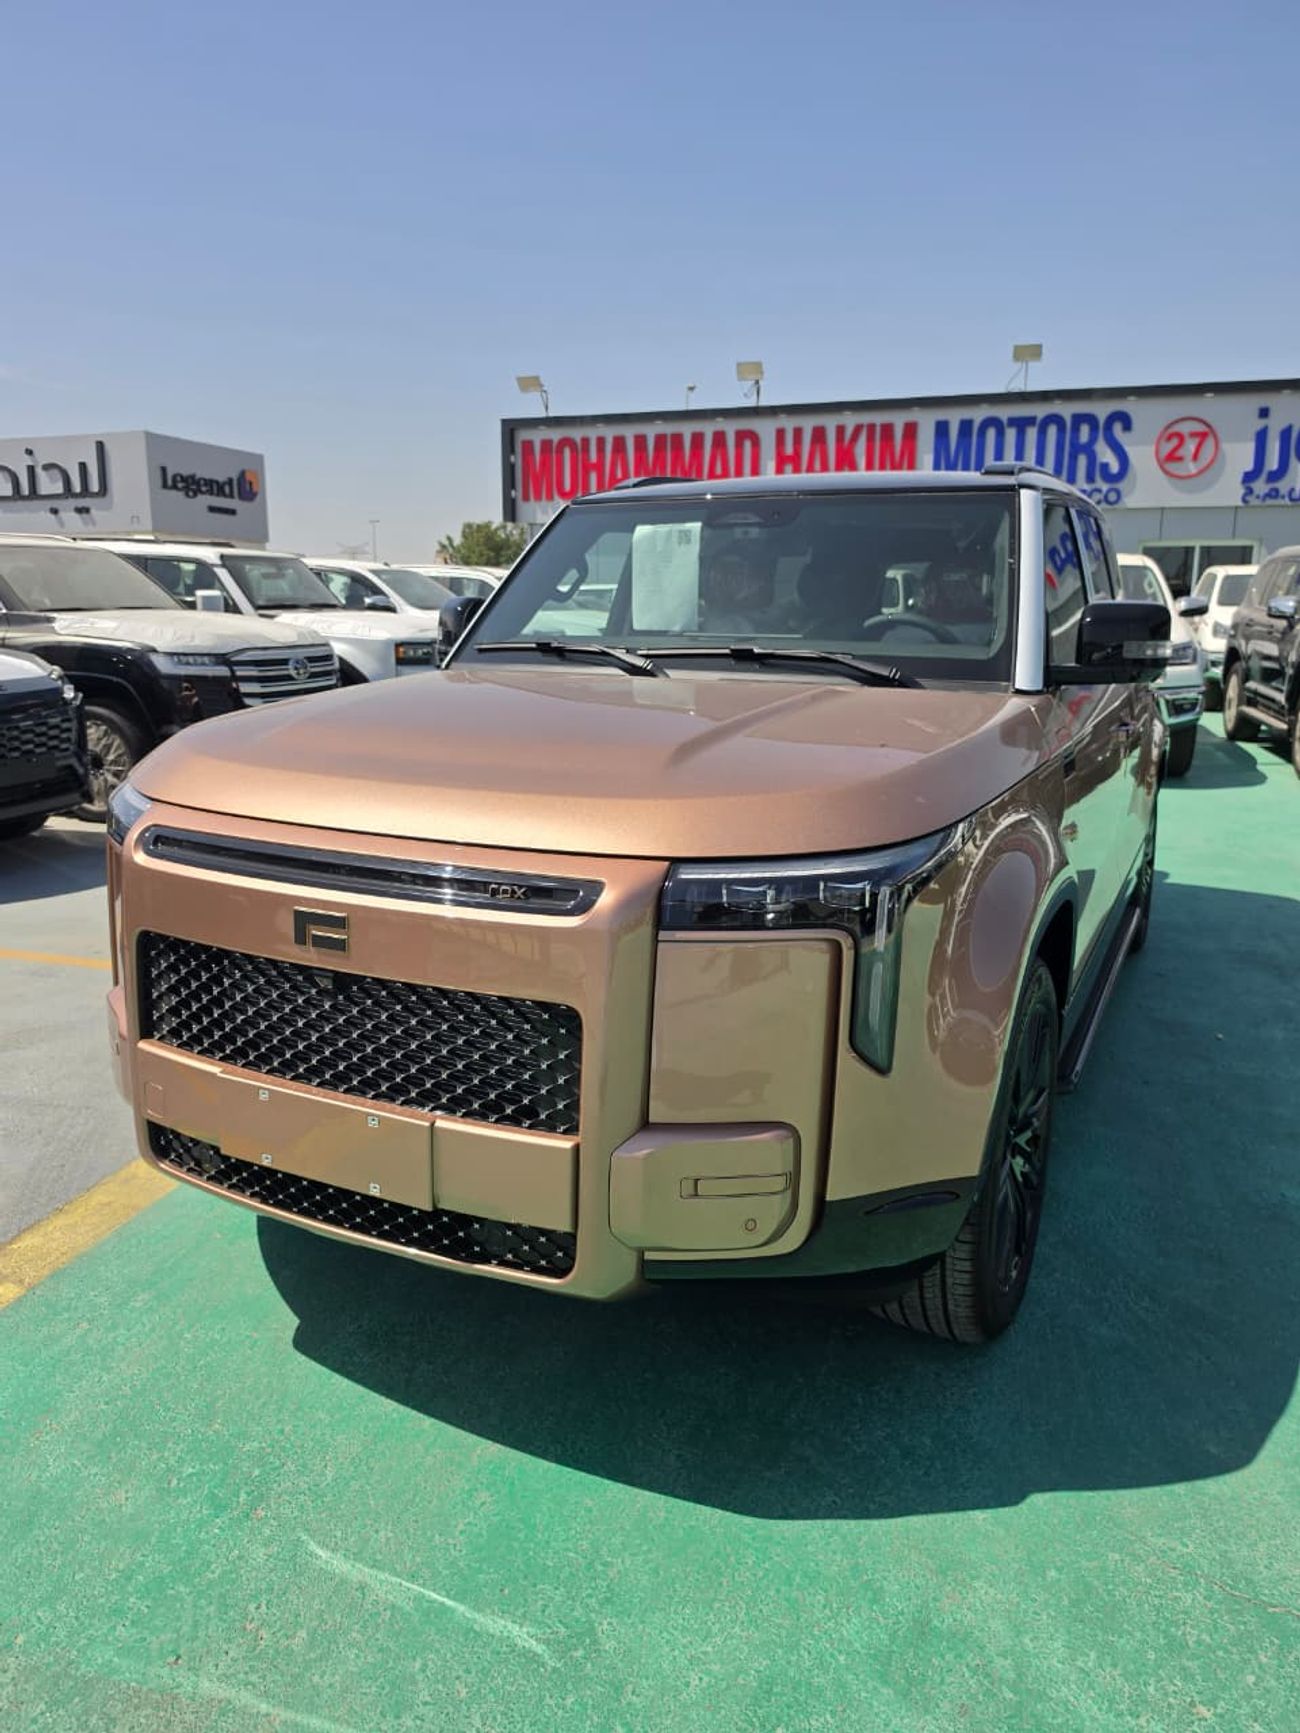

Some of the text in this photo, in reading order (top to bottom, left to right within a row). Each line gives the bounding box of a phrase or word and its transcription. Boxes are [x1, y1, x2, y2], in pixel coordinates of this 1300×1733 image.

[521, 409, 1133, 502] MOHAMMAD HAKIM MOTORS
[1163, 430, 1210, 463] 27
[159, 465, 236, 499] Legend
